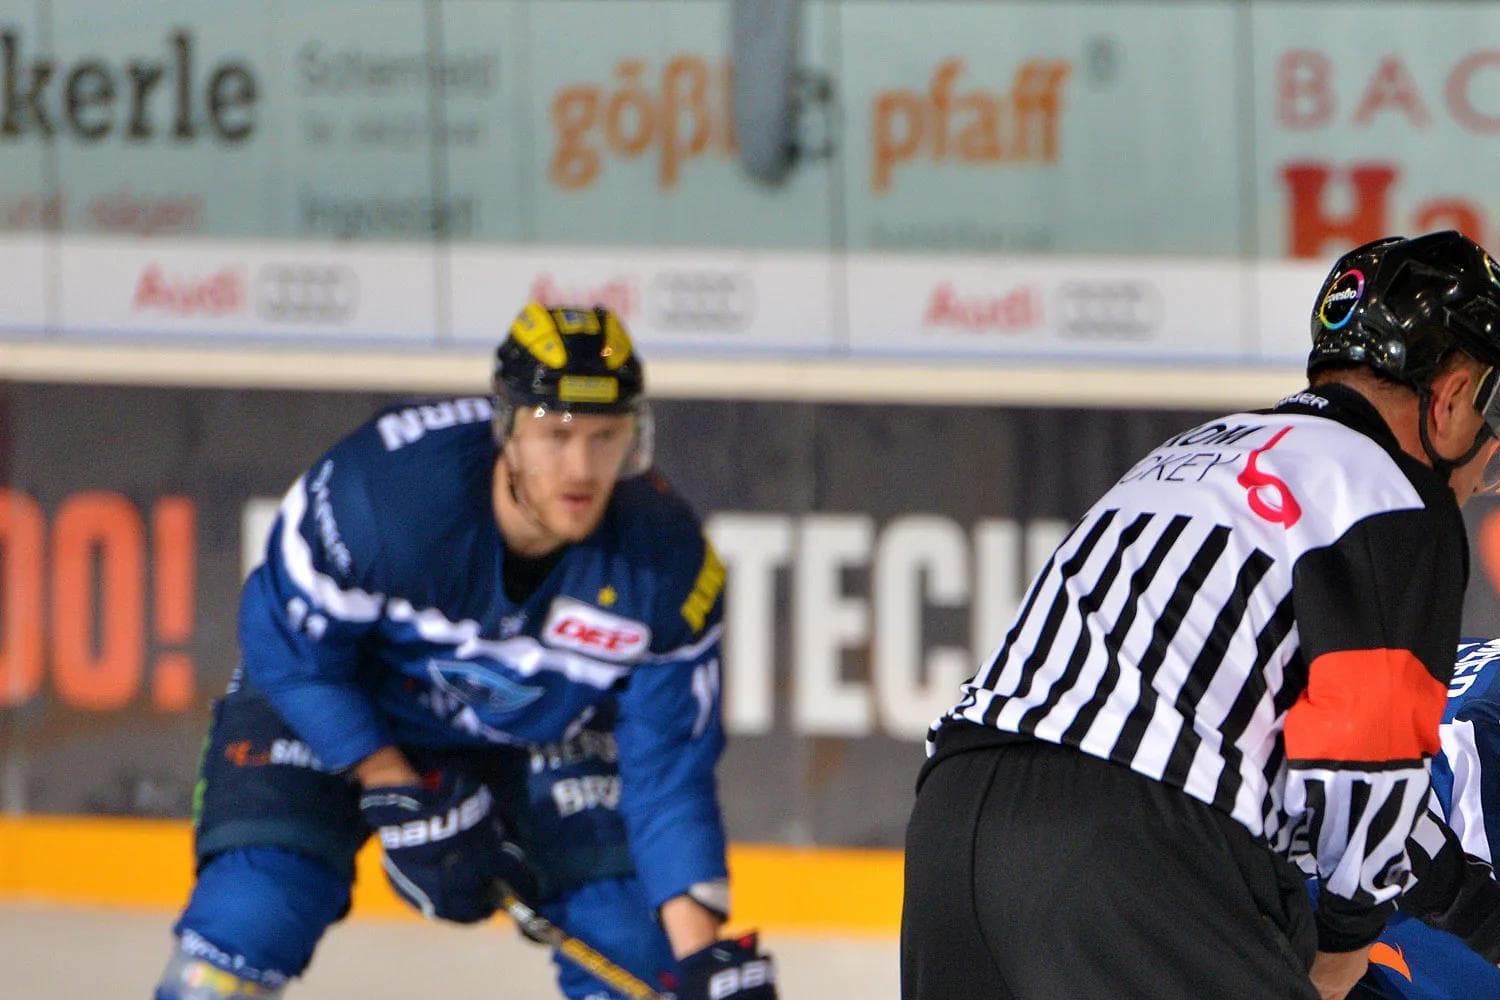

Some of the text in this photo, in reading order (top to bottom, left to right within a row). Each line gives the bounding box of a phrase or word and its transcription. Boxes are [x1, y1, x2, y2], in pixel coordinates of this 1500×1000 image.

[868, 55, 1072, 193] pfaff
[925, 282, 1044, 331] Audi
[1273, 391, 1329, 411] UER
[378, 784, 493, 853] BAUE
